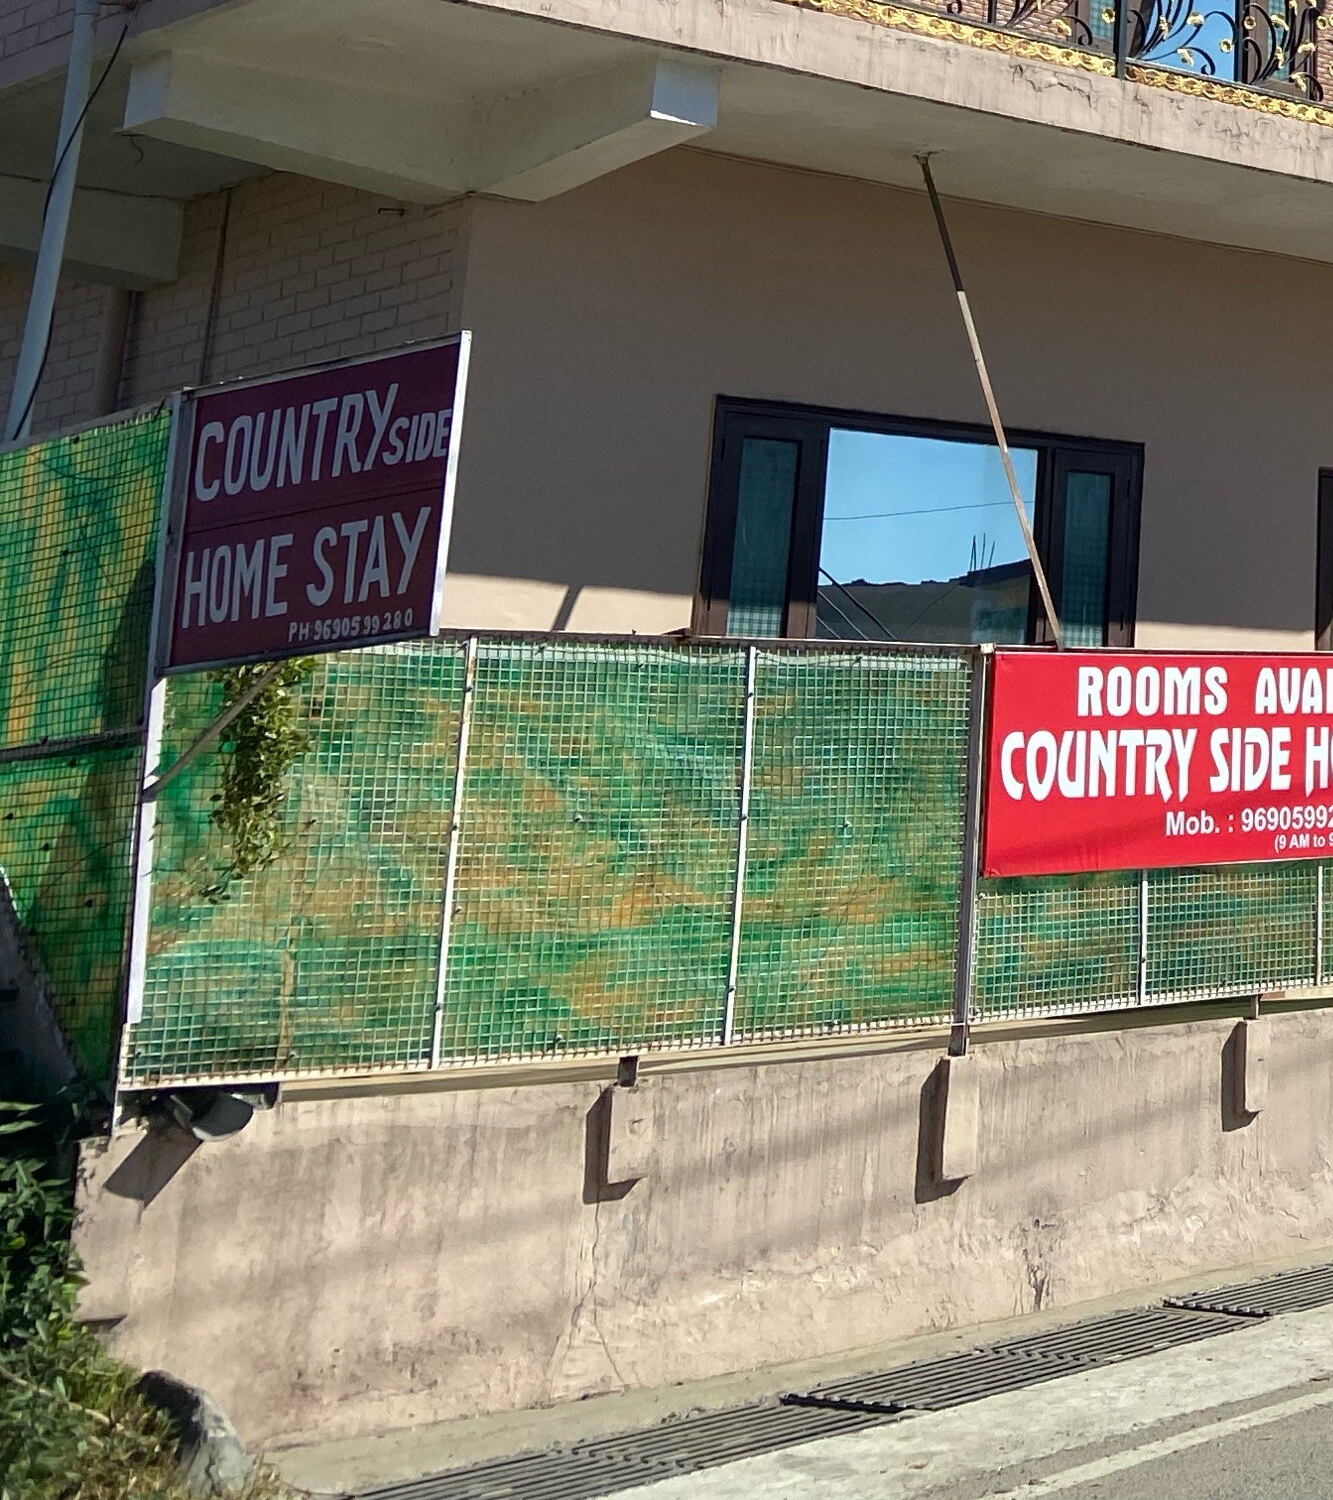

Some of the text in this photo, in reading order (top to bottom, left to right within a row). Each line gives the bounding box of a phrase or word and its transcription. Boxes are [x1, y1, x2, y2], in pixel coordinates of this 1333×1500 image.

[194, 383, 452, 502] COUNTRY SIDE
[181, 506, 432, 629] HOME STAY
[1076, 666, 1228, 717] ROOMS
[1000, 727, 1198, 803] COUNTRY
[1209, 727, 1292, 794] SIDE
[1165, 809, 1221, 836] Mob.
[1274, 834, 1287, 853] (9
[1289, 833, 1310, 850] AM
[1312, 834, 1326, 849] to
